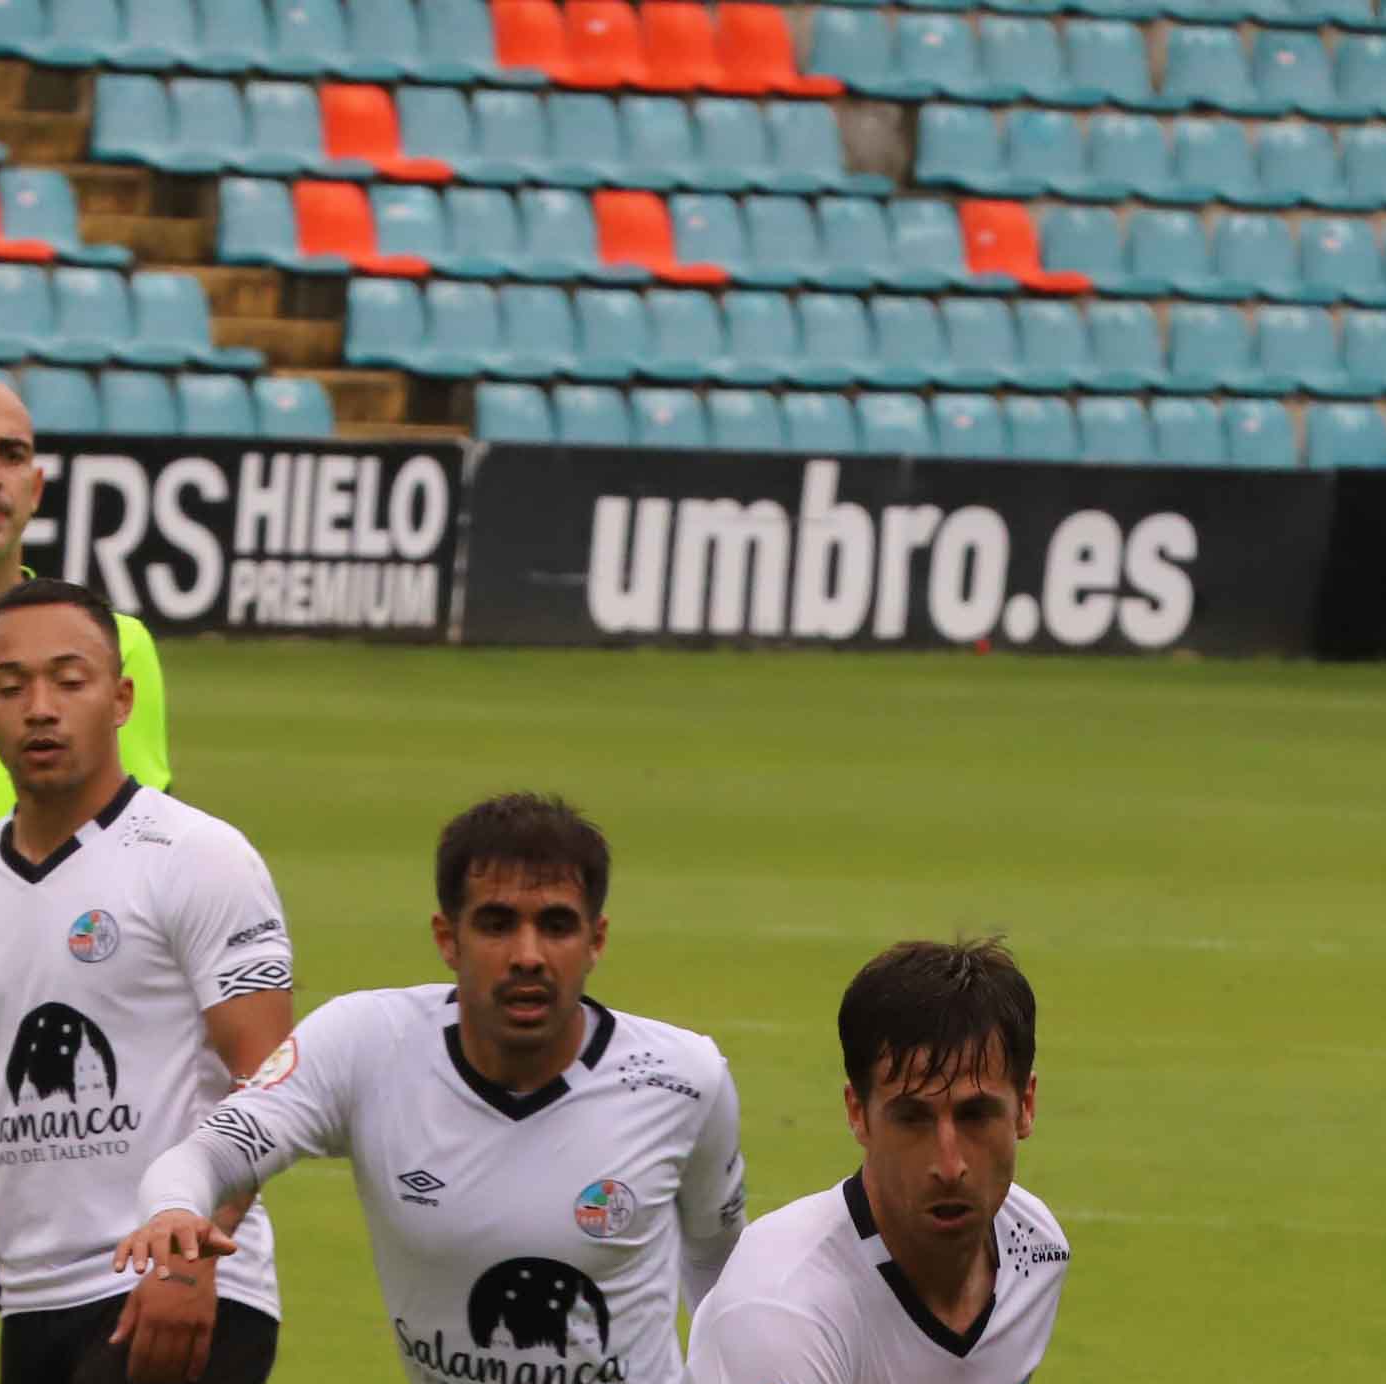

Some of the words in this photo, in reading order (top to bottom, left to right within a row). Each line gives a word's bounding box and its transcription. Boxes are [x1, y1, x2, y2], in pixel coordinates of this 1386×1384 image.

[233, 451, 450, 561] HIELO
[588, 459, 1198, 648] umbro.es
[227, 559, 439, 629] PREMIUM
